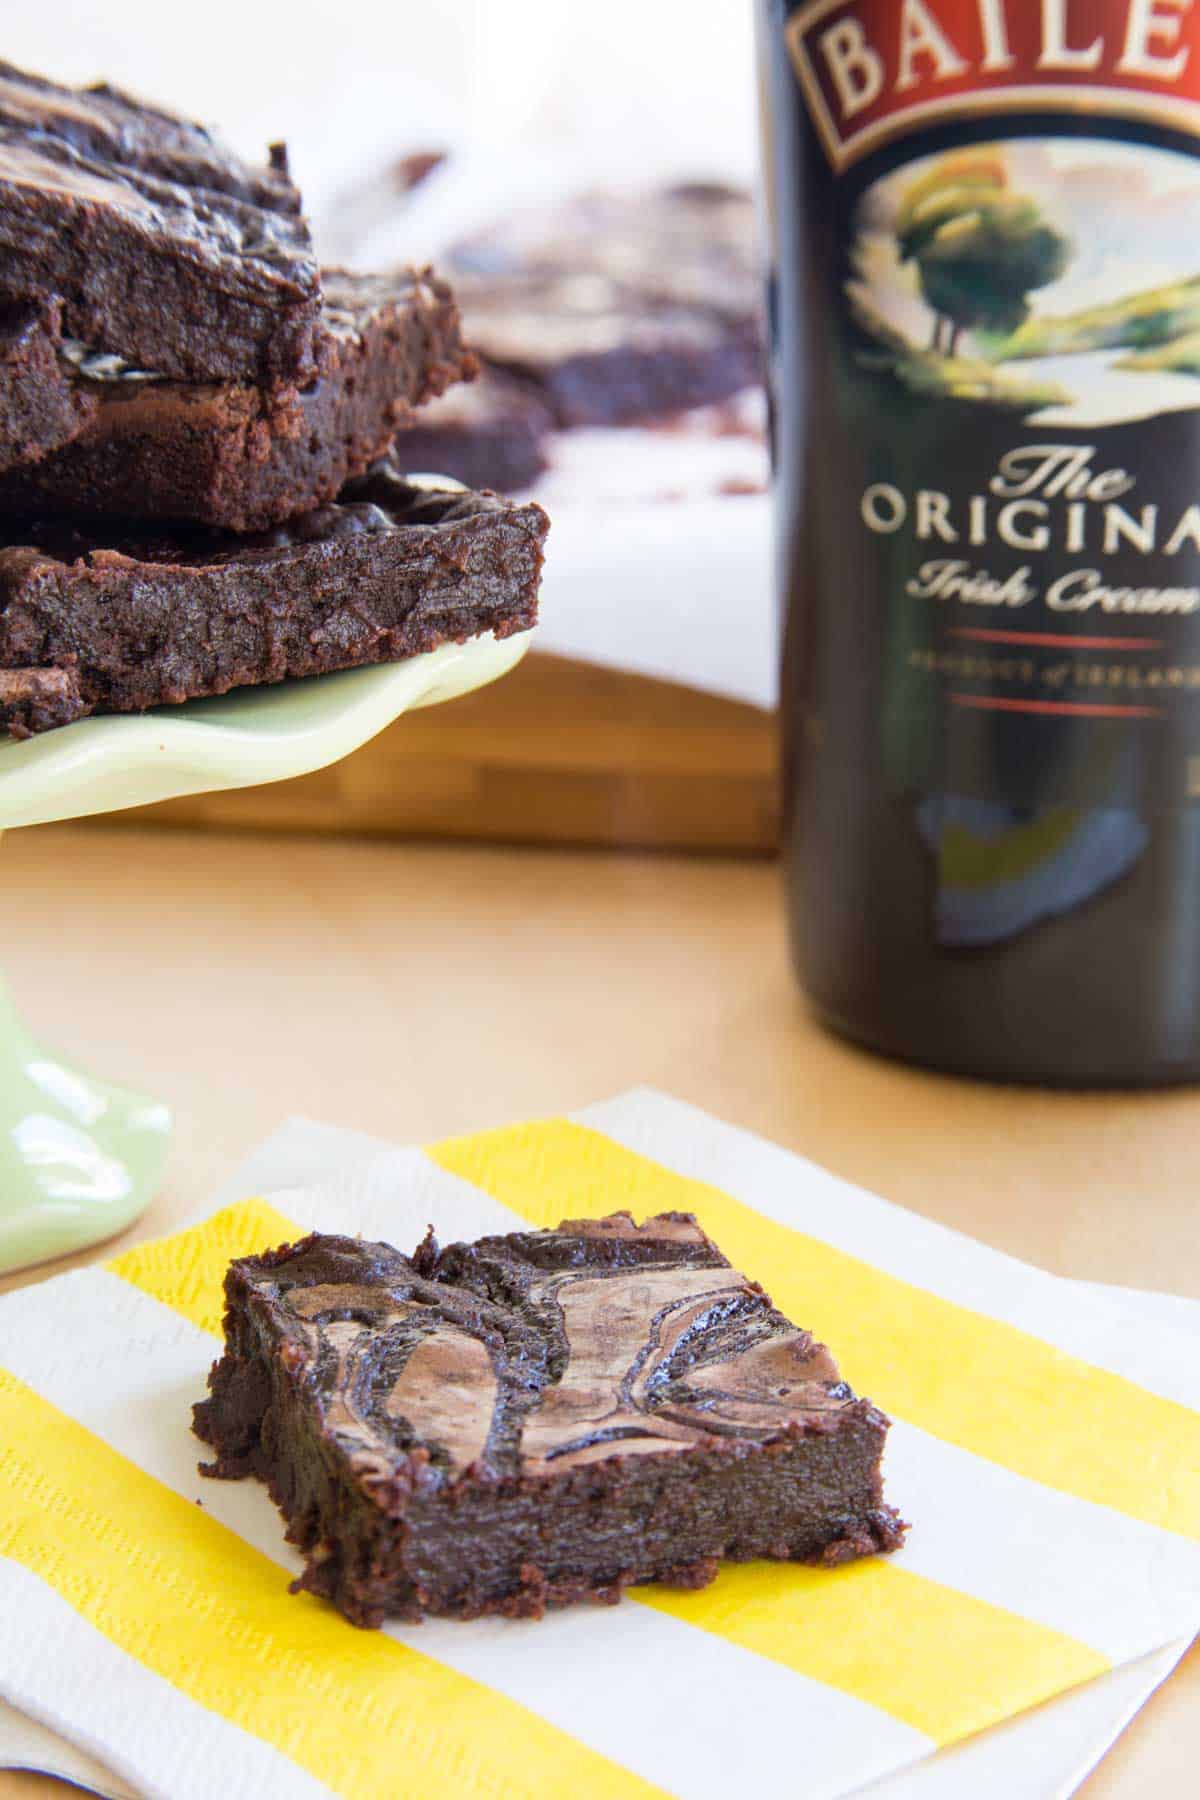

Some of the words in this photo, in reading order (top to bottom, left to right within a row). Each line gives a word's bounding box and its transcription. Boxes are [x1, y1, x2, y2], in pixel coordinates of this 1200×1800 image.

[819, 0, 1192, 119] BAILE
[990, 444, 1136, 501] The
[861, 482, 1200, 555] ORIGINA
[905, 559, 1037, 608] Irish
[1045, 568, 1200, 614] Cream
